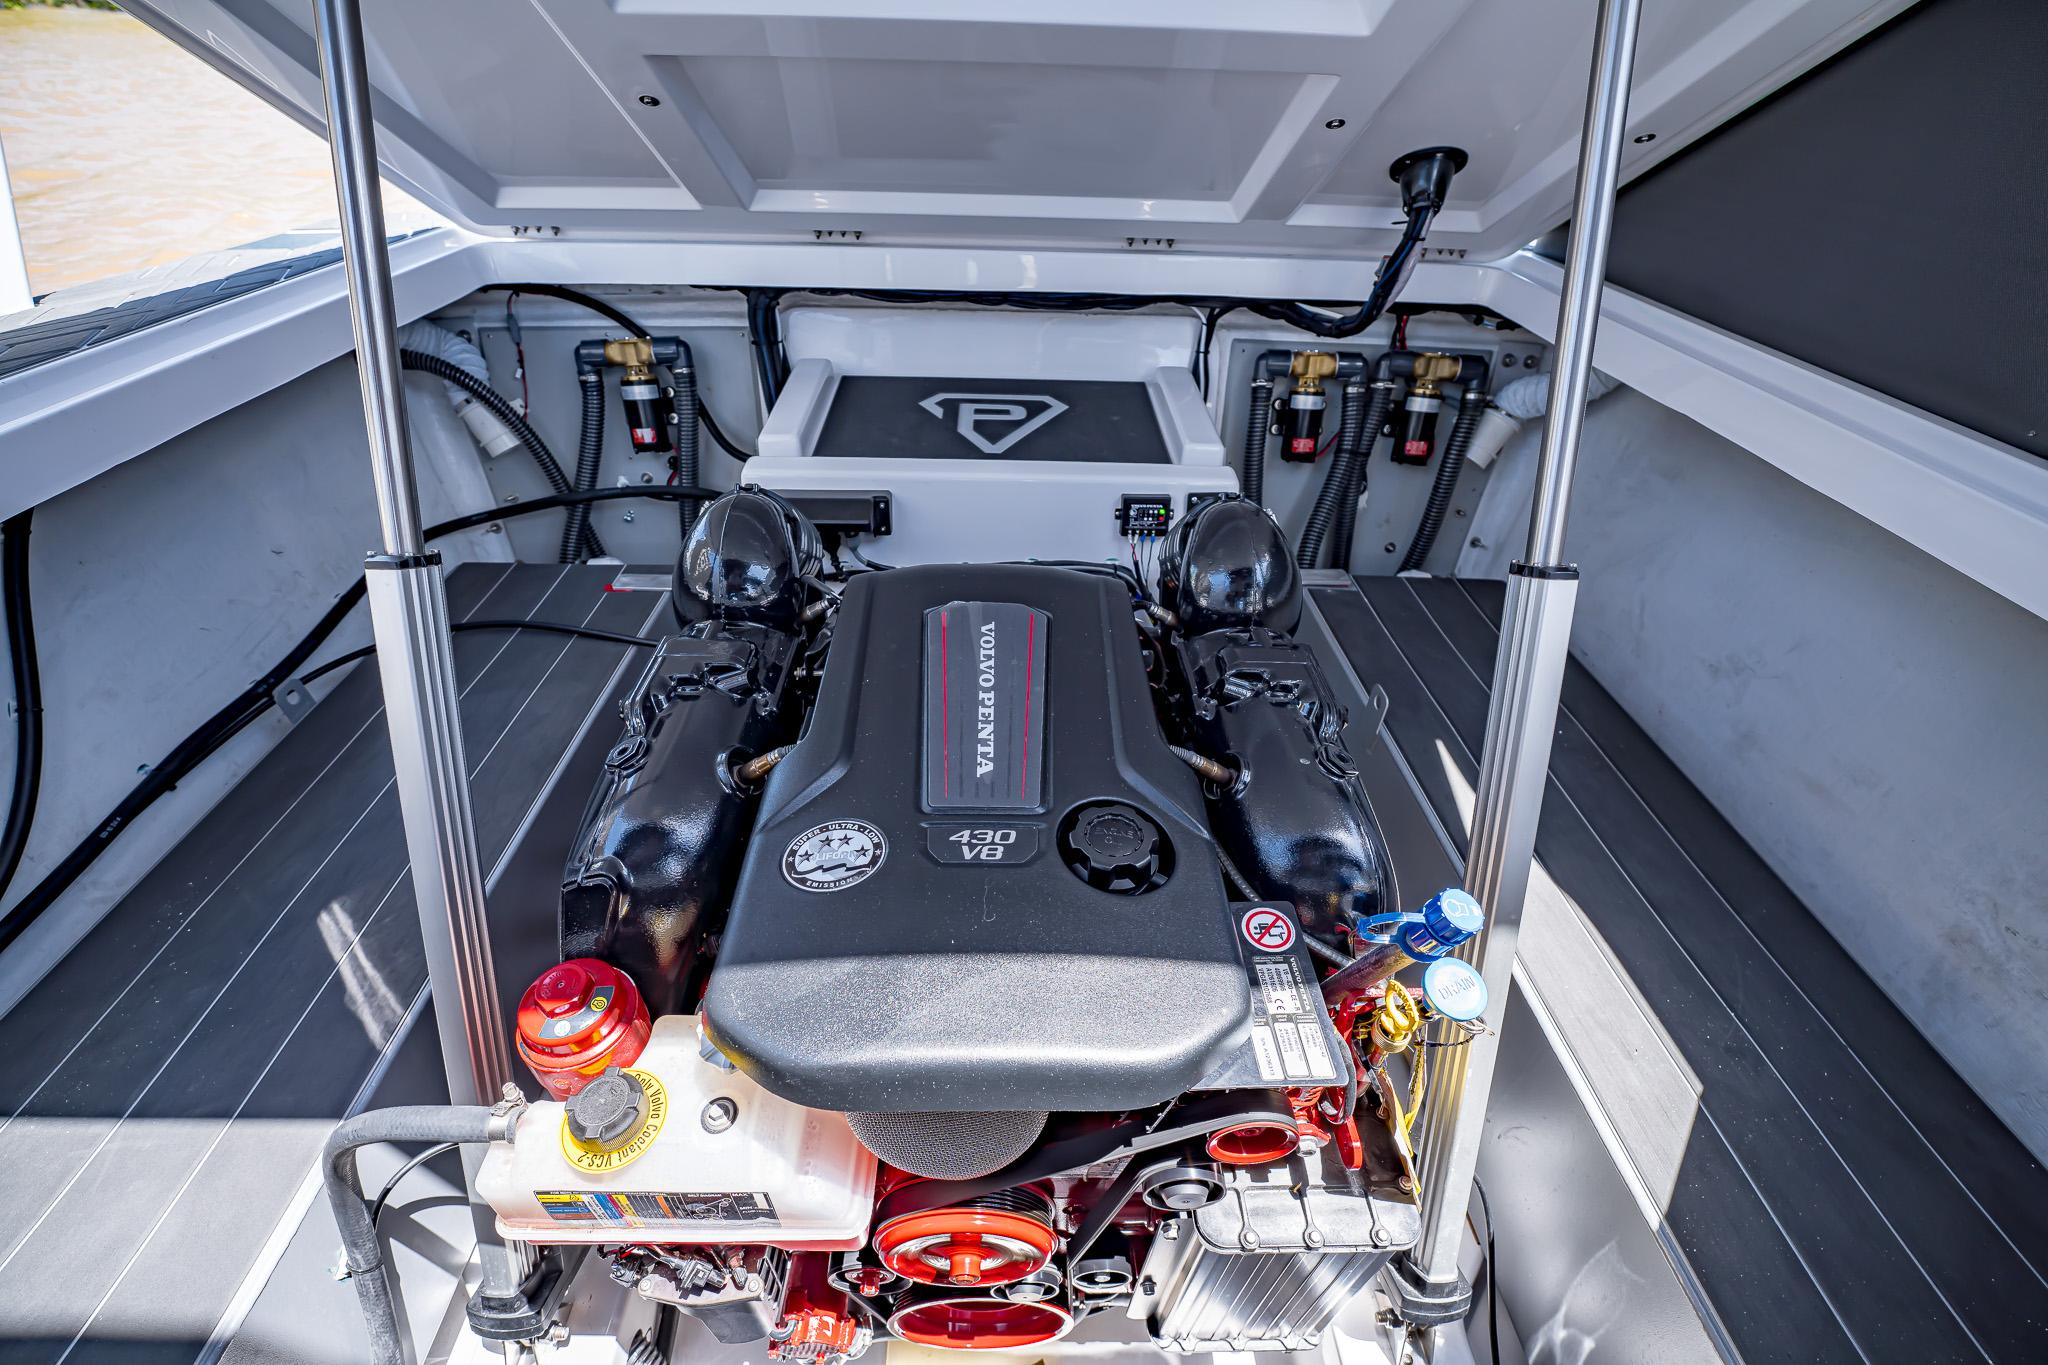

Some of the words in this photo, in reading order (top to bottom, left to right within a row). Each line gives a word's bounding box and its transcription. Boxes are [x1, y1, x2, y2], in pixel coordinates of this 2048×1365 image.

[978, 621, 995, 688] VOLVO
[976, 690, 995, 778] PENTA
[793, 829, 821, 851] SUPER
[828, 823, 859, 831] ULTRA
[863, 829, 881, 844] LOW
[949, 829, 1017, 845] 430
[961, 845, 1004, 861] V8
[806, 878, 854, 889] EMISSION
[1290, 957, 1302, 983] VOLVO
[1298, 983, 1312, 1011] PENTA
[1438, 975, 1477, 1000] DRAIN
[634, 1073, 654, 1091] Only
[650, 1088, 664, 1120] Volvo
[577, 1150, 612, 1168] VCS-2
